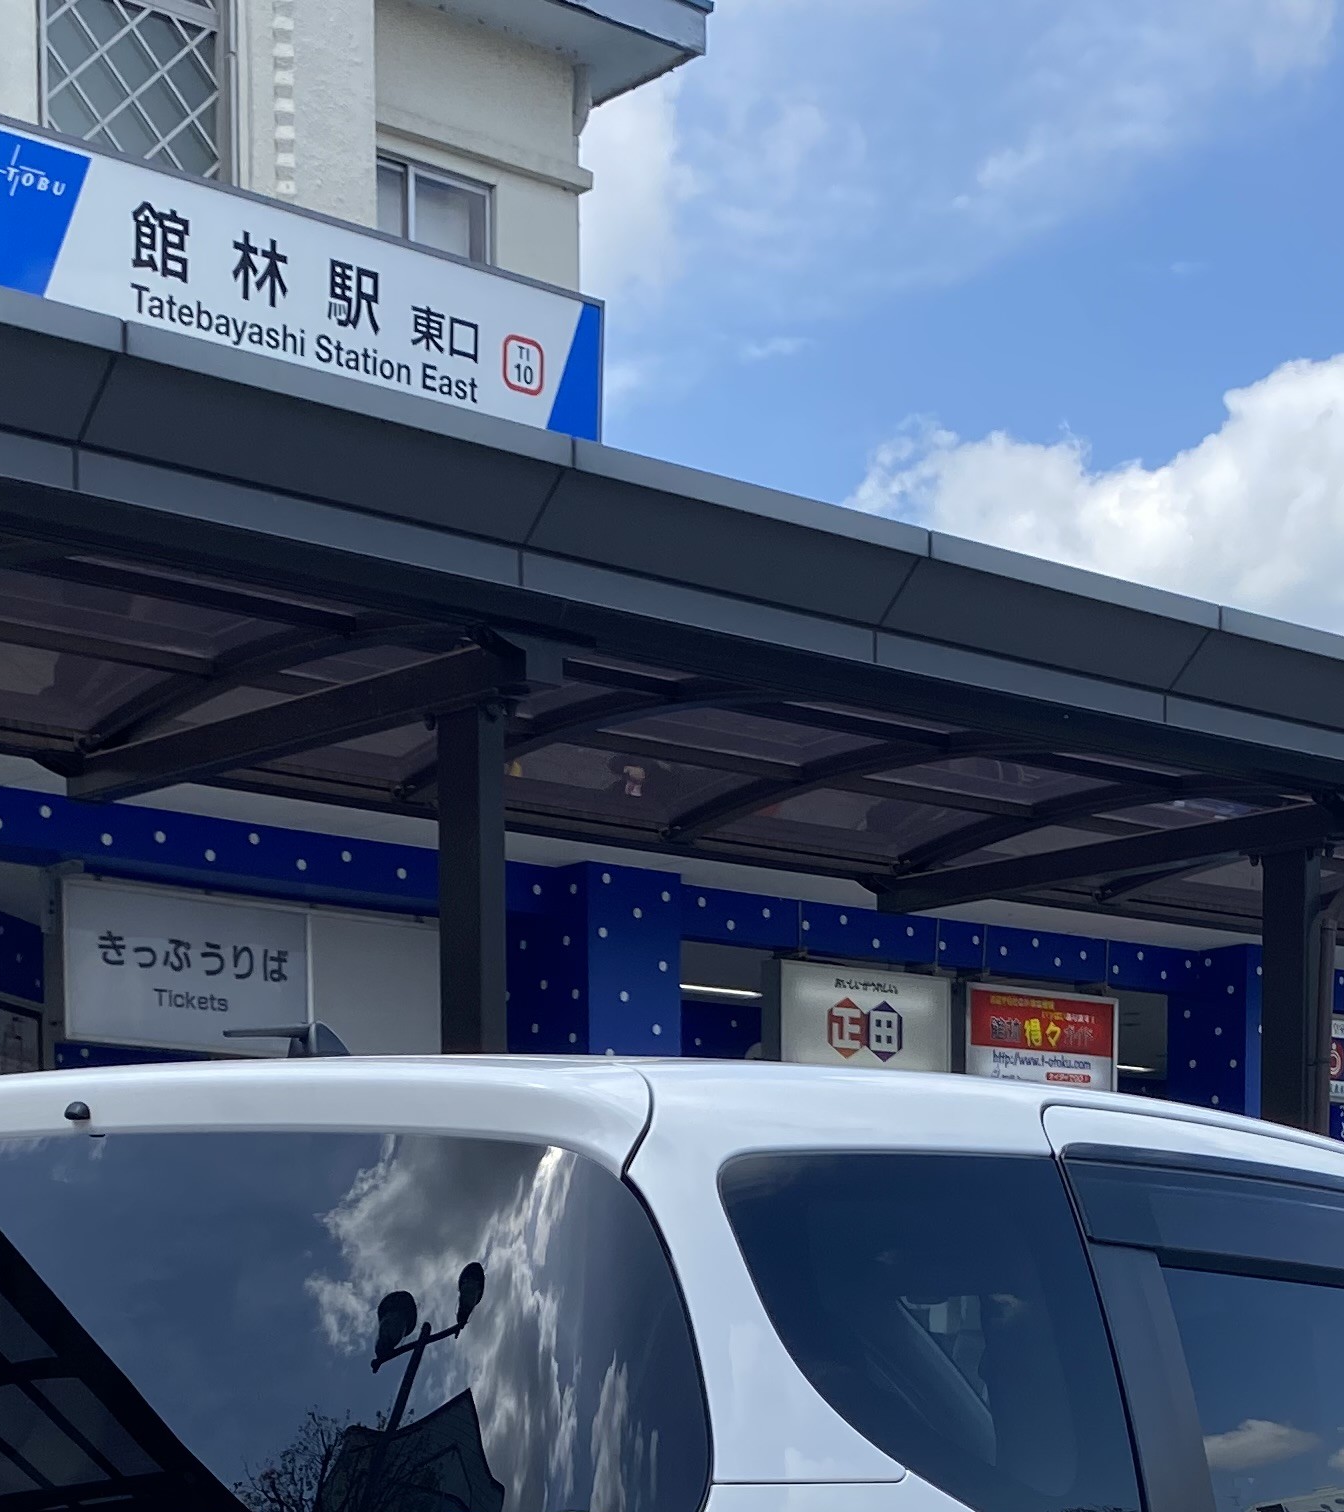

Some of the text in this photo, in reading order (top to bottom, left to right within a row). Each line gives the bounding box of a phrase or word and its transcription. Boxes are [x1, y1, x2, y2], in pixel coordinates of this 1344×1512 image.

[7, 166, 66, 196] TOBU
[132, 201, 478, 364] 館林駅 東口
[130, 283, 478, 404] Tatebayashi Station East
[514, 363, 533, 385] 10
[97, 929, 288, 983] きっぷうりば
[153, 987, 229, 1012] Tickets
